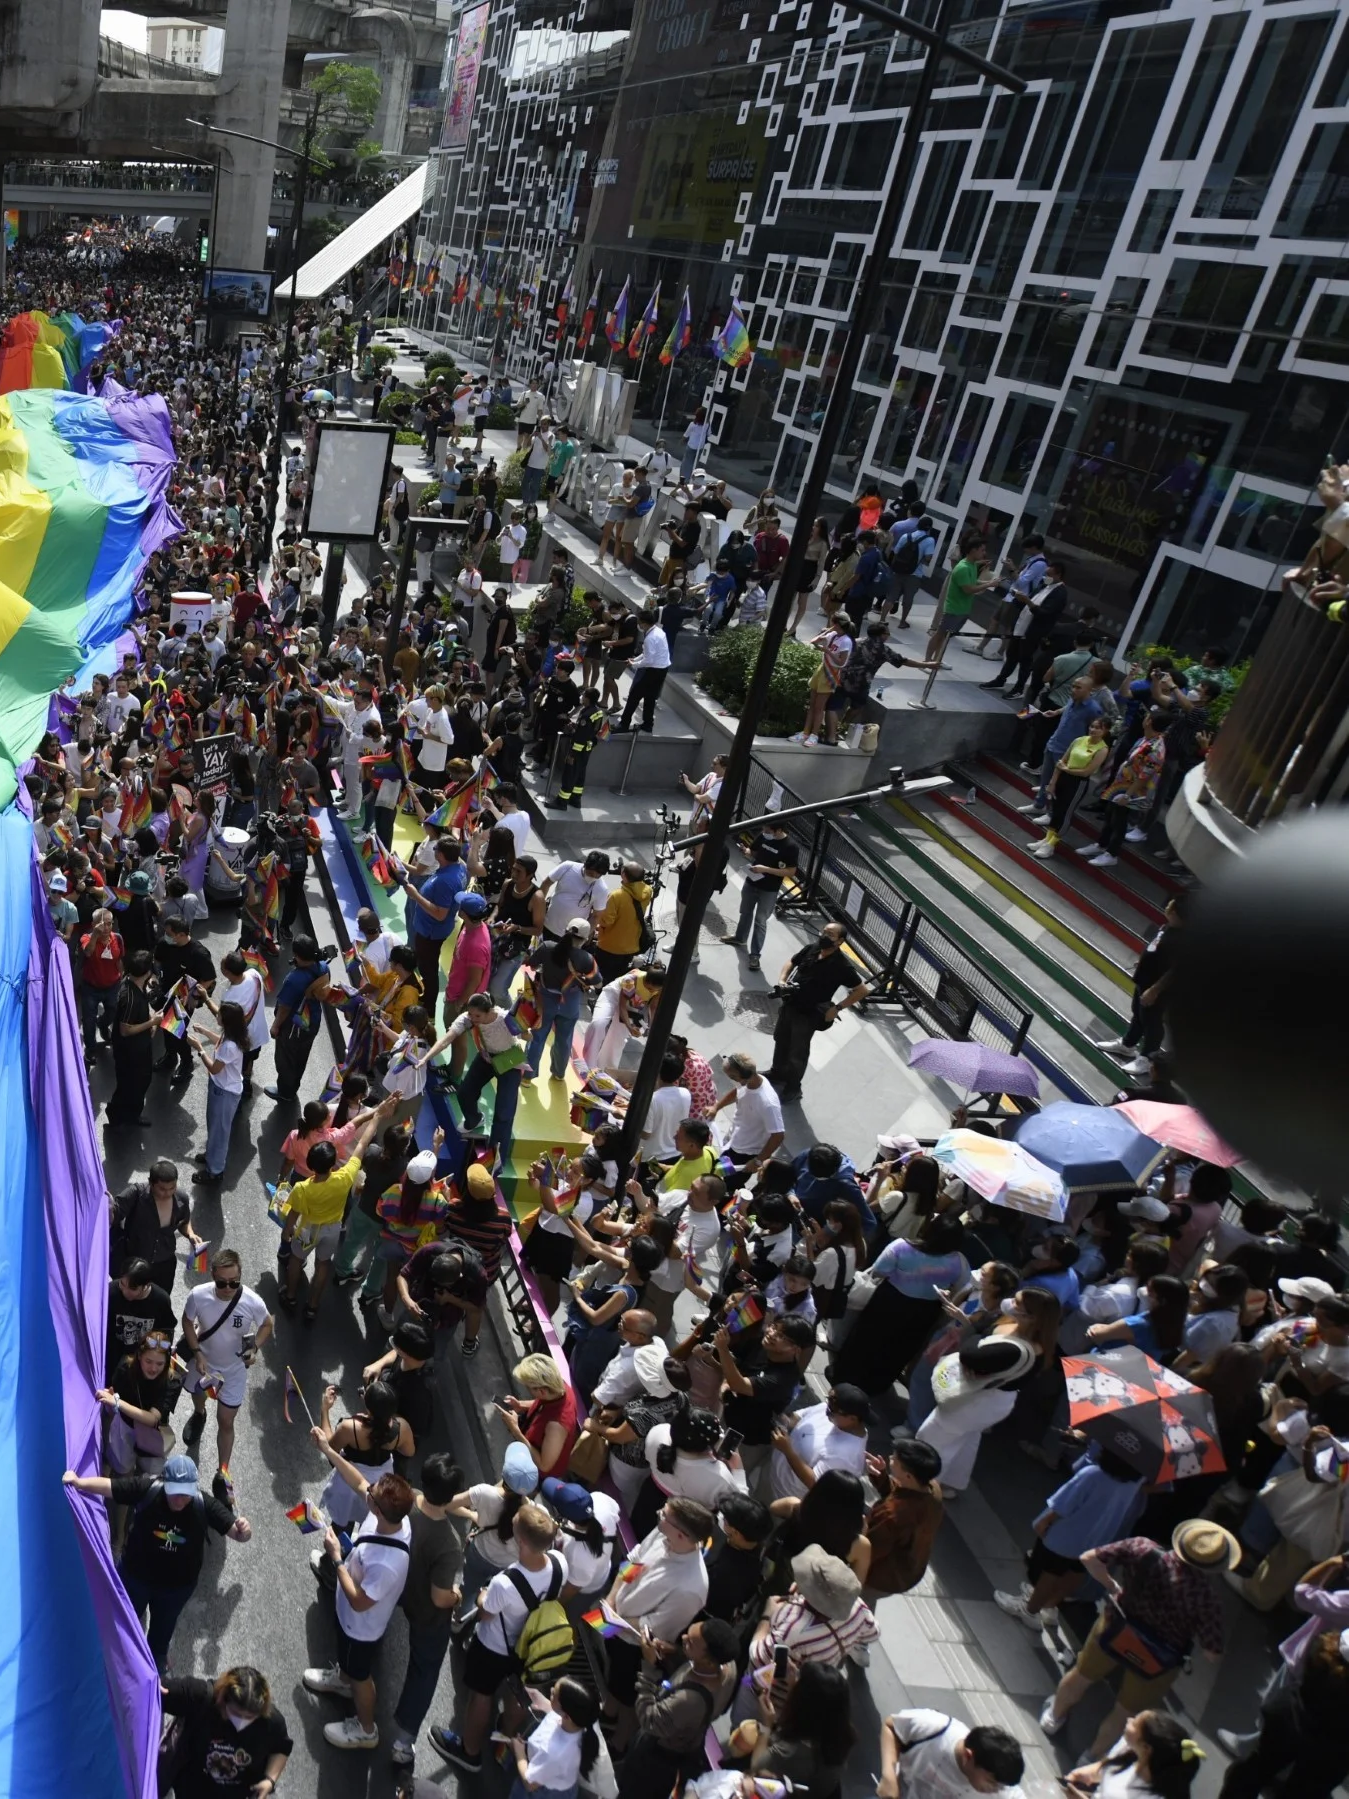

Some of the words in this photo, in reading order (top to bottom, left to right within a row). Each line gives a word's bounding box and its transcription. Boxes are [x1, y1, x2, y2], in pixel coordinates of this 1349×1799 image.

[657, 8, 711, 53] CRAFT
[707, 160, 756, 180] SURPRISE
[203, 750, 228, 769] YAY
[203, 762, 227, 778] today!
